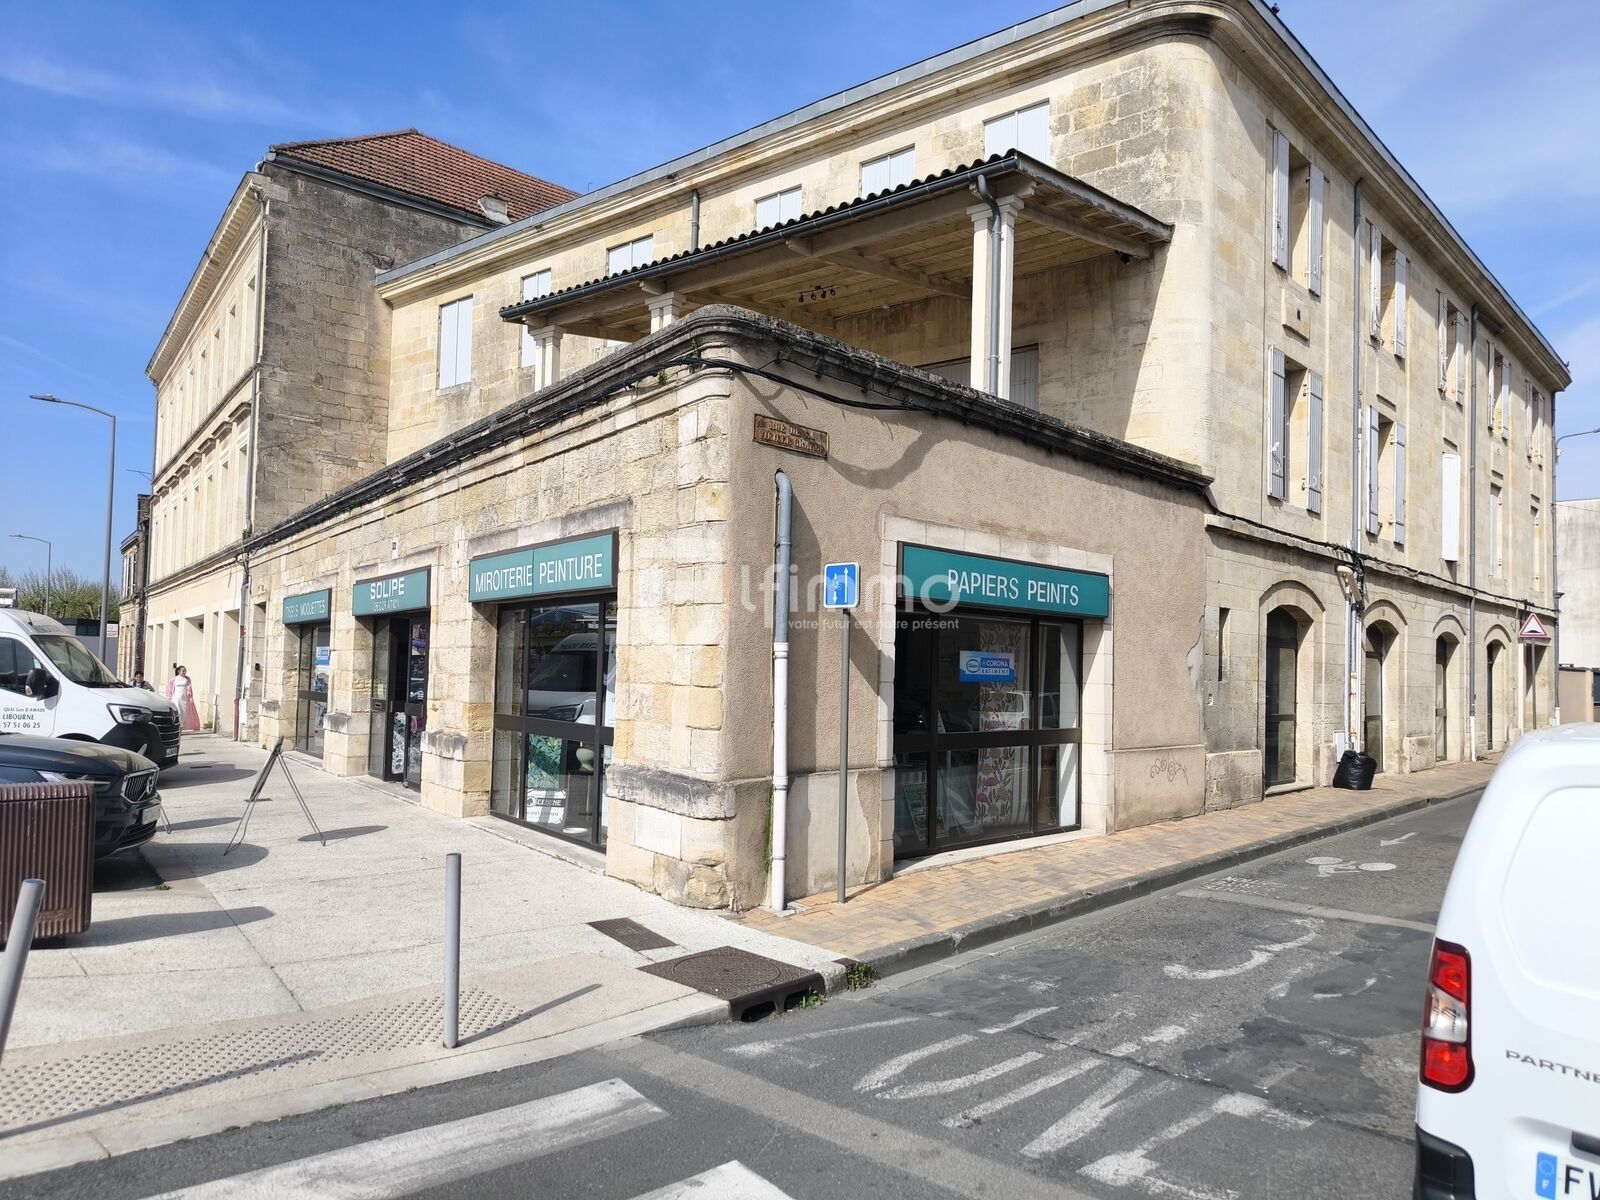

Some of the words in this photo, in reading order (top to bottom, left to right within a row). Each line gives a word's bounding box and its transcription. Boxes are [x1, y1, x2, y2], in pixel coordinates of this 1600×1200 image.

[475, 564, 533, 593] MIROITERIE
[540, 553, 603, 585] PEINTURE
[370, 577, 405, 600] SOLIPE
[948, 569, 1019, 600] PAPIERS
[1027, 579, 1079, 606] PEINTS
[986, 659, 1009, 667] CORONA
[2, 713, 35, 721] LIBOURNE
[22, 721, 31, 729] 06
[33, 721, 41, 729] 25
